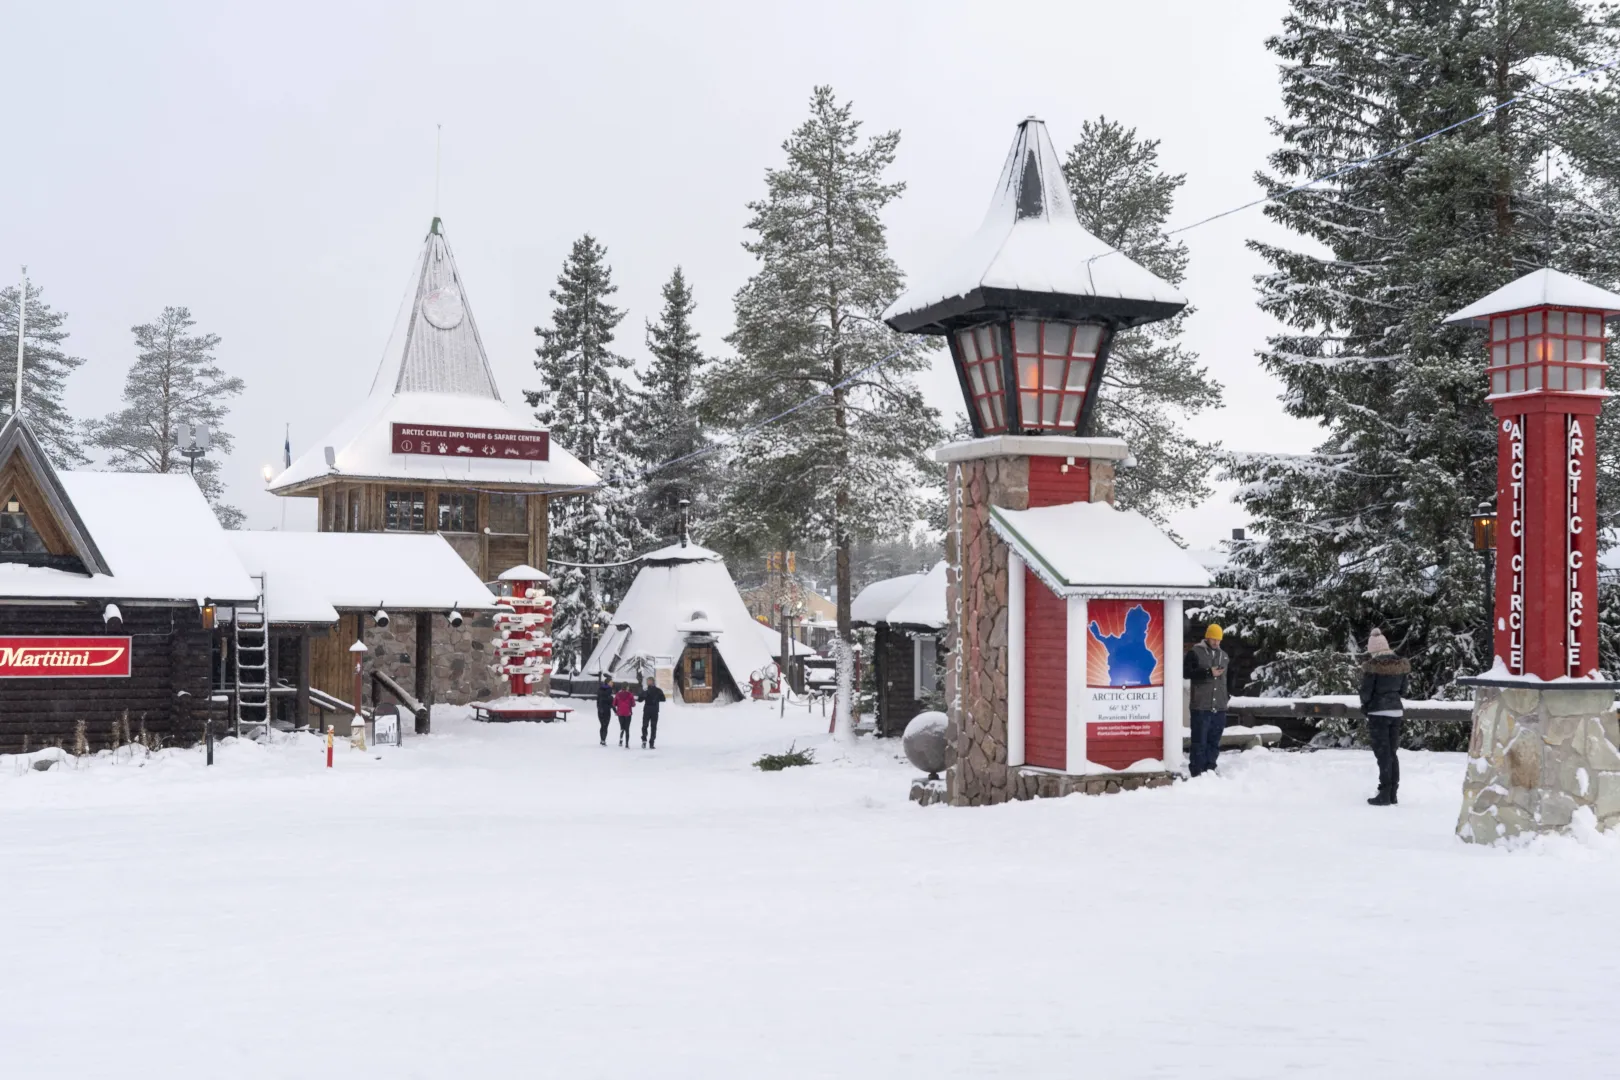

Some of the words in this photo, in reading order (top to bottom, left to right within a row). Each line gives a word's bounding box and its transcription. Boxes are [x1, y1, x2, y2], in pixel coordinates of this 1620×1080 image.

[401, 428, 424, 437] ARCTIC
[426, 429, 447, 438] CIRCLE
[449, 430, 465, 439] INFO
[466, 431, 486, 440] TOWER
[487, 432, 493, 440] &
[494, 433, 517, 441] SAFARI
[518, 434, 541, 442] CENTER
[1509, 424, 1522, 537] ARCTIC
[1568, 420, 1583, 534] ARCTIC
[954, 464, 964, 582] ARCTIC
[0, 647, 90, 667] Marttiini
[954, 598, 964, 711] CIRCLE
[1509, 554, 1522, 668] CIRCLE
[1568, 550, 1583, 666] CIRCLE
[1092, 692, 1125, 701] ARCTIC
[1126, 692, 1158, 701] CIRCLE
